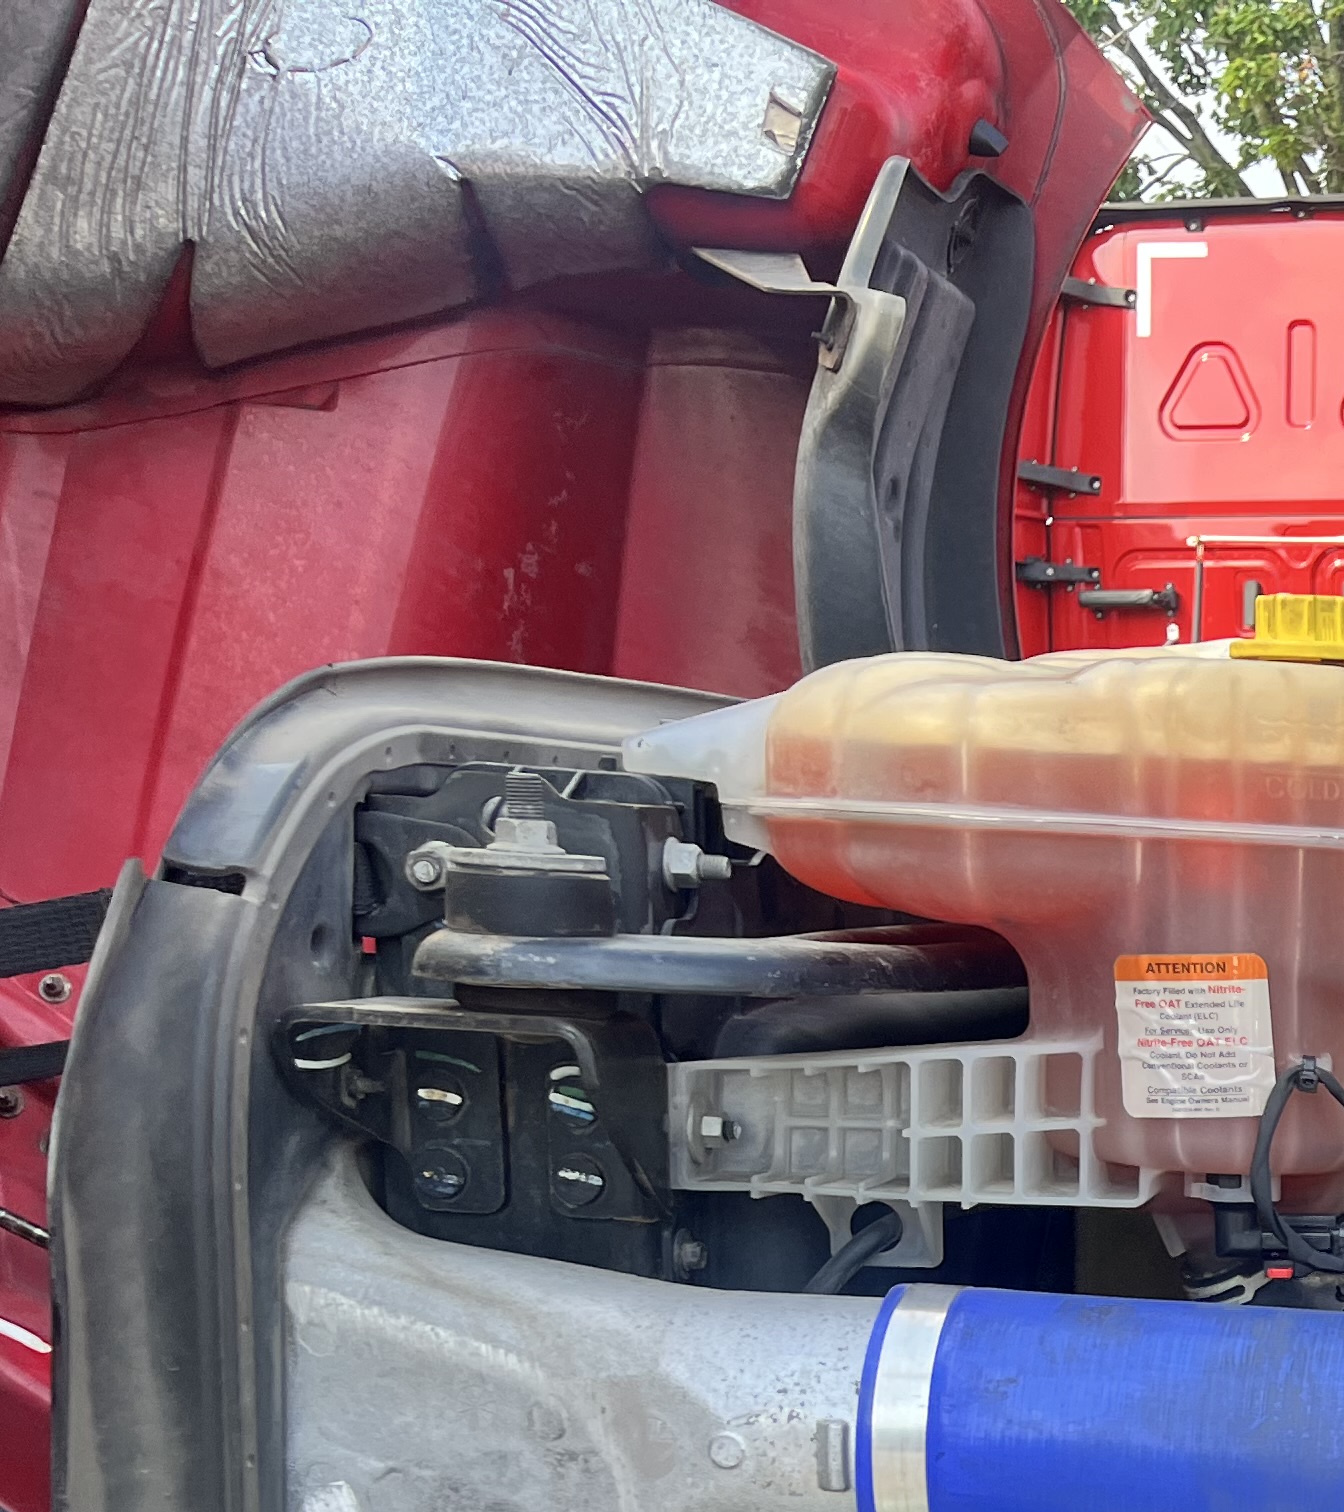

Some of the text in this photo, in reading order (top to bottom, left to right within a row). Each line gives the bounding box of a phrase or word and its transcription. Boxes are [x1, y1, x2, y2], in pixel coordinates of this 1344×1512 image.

[1266, 776, 1340, 800] COLD
[1145, 961, 1227, 974] ATTENTION
[1135, 999, 1156, 1008] Free
[1159, 999, 1182, 1008] OAT
[1185, 1000, 1225, 1008] Extended
